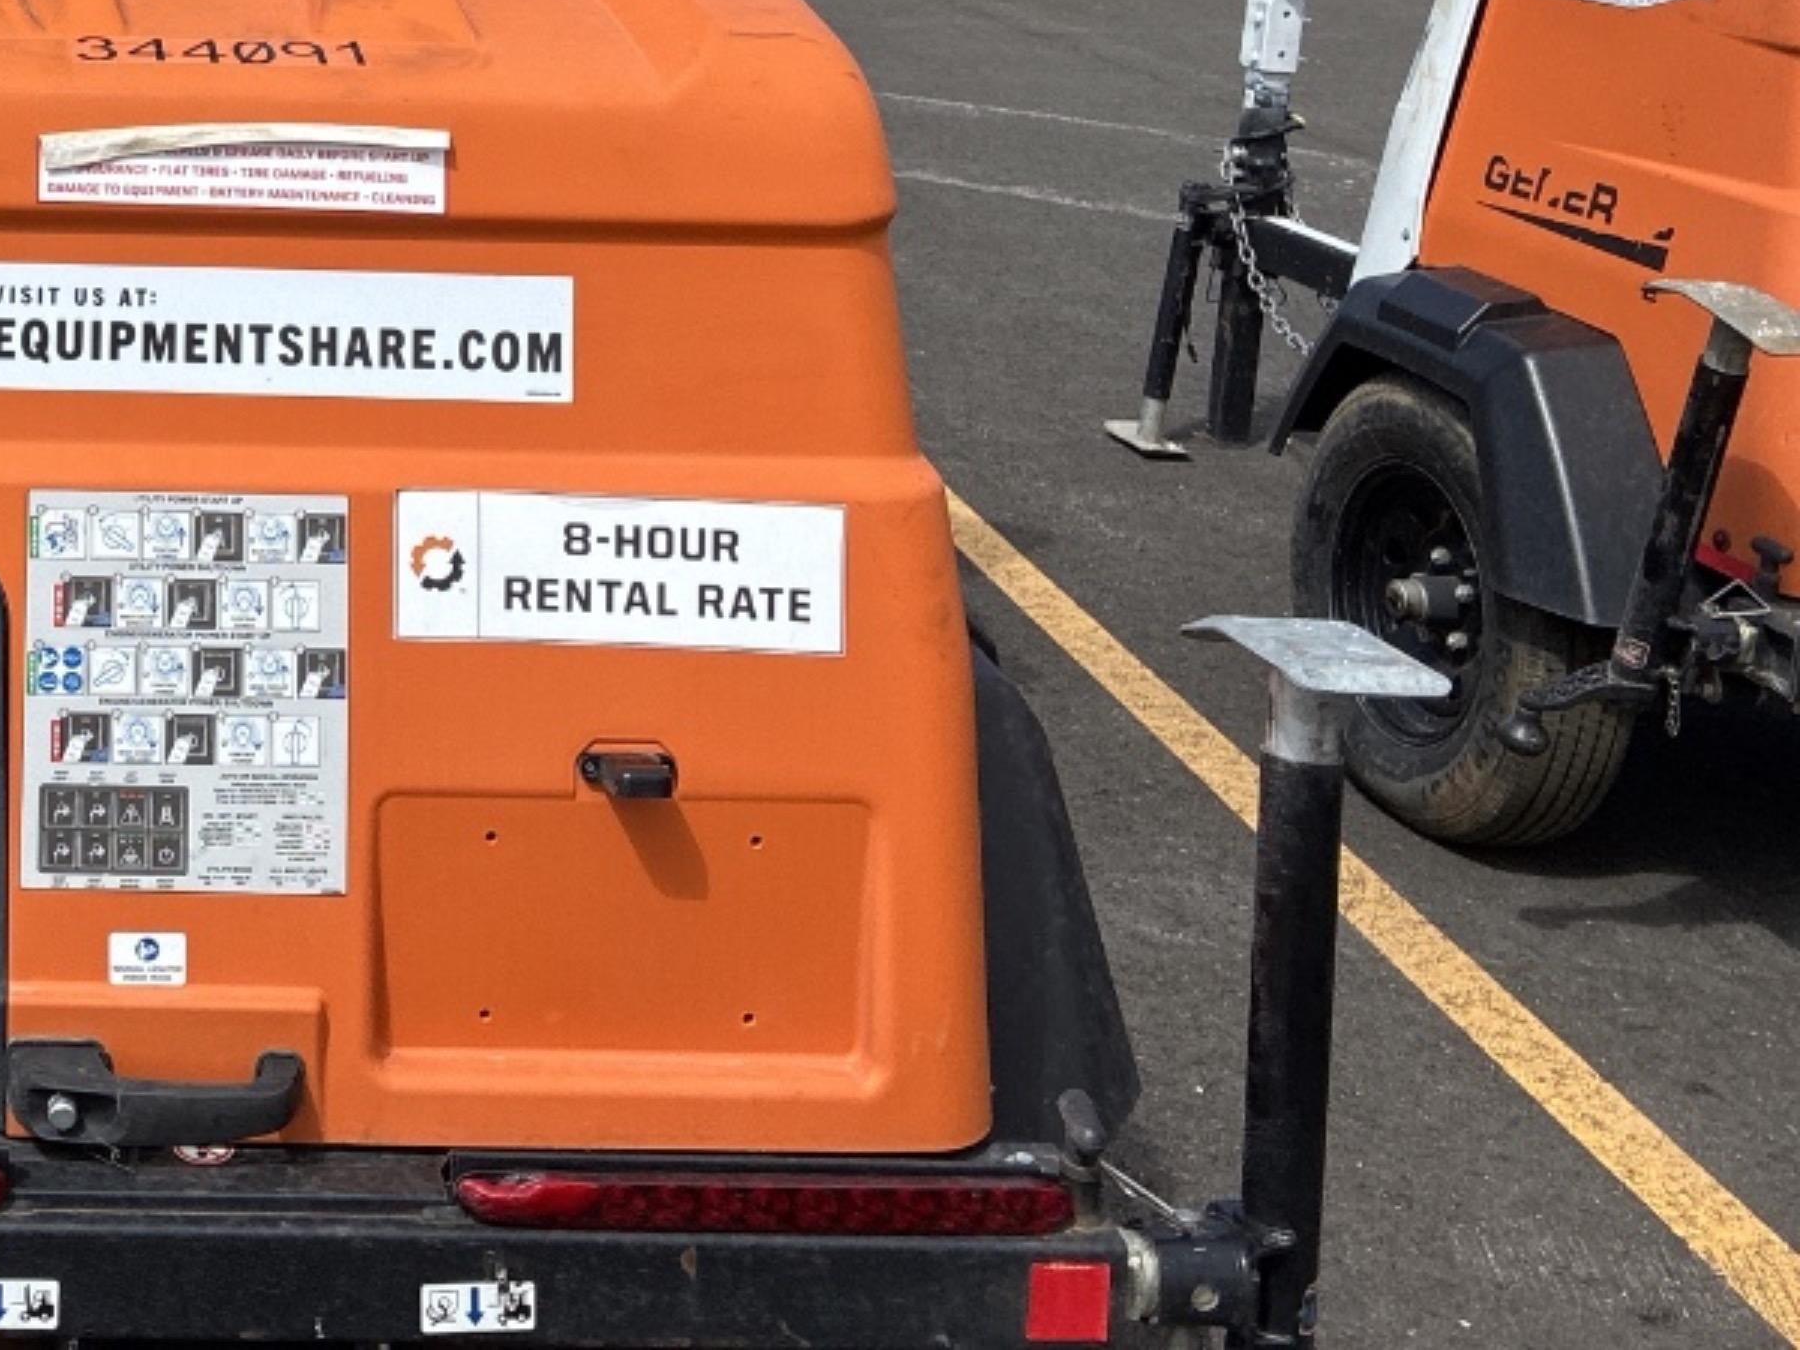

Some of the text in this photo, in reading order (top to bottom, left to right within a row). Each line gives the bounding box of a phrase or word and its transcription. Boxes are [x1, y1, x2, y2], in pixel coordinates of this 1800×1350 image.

[76, 35, 367, 66] 344091
[273, 168, 325, 180] DAMAGE
[47, 182, 100, 194] DAMAGE
[104, 183, 121, 195] TO
[123, 184, 199, 198] EQUIPMENT
[74, 287, 106, 307] US
[118, 288, 158, 307] AT:
[562, 521, 741, 563] 8-HOUR
[503, 575, 812, 624] RENTAL RATE
